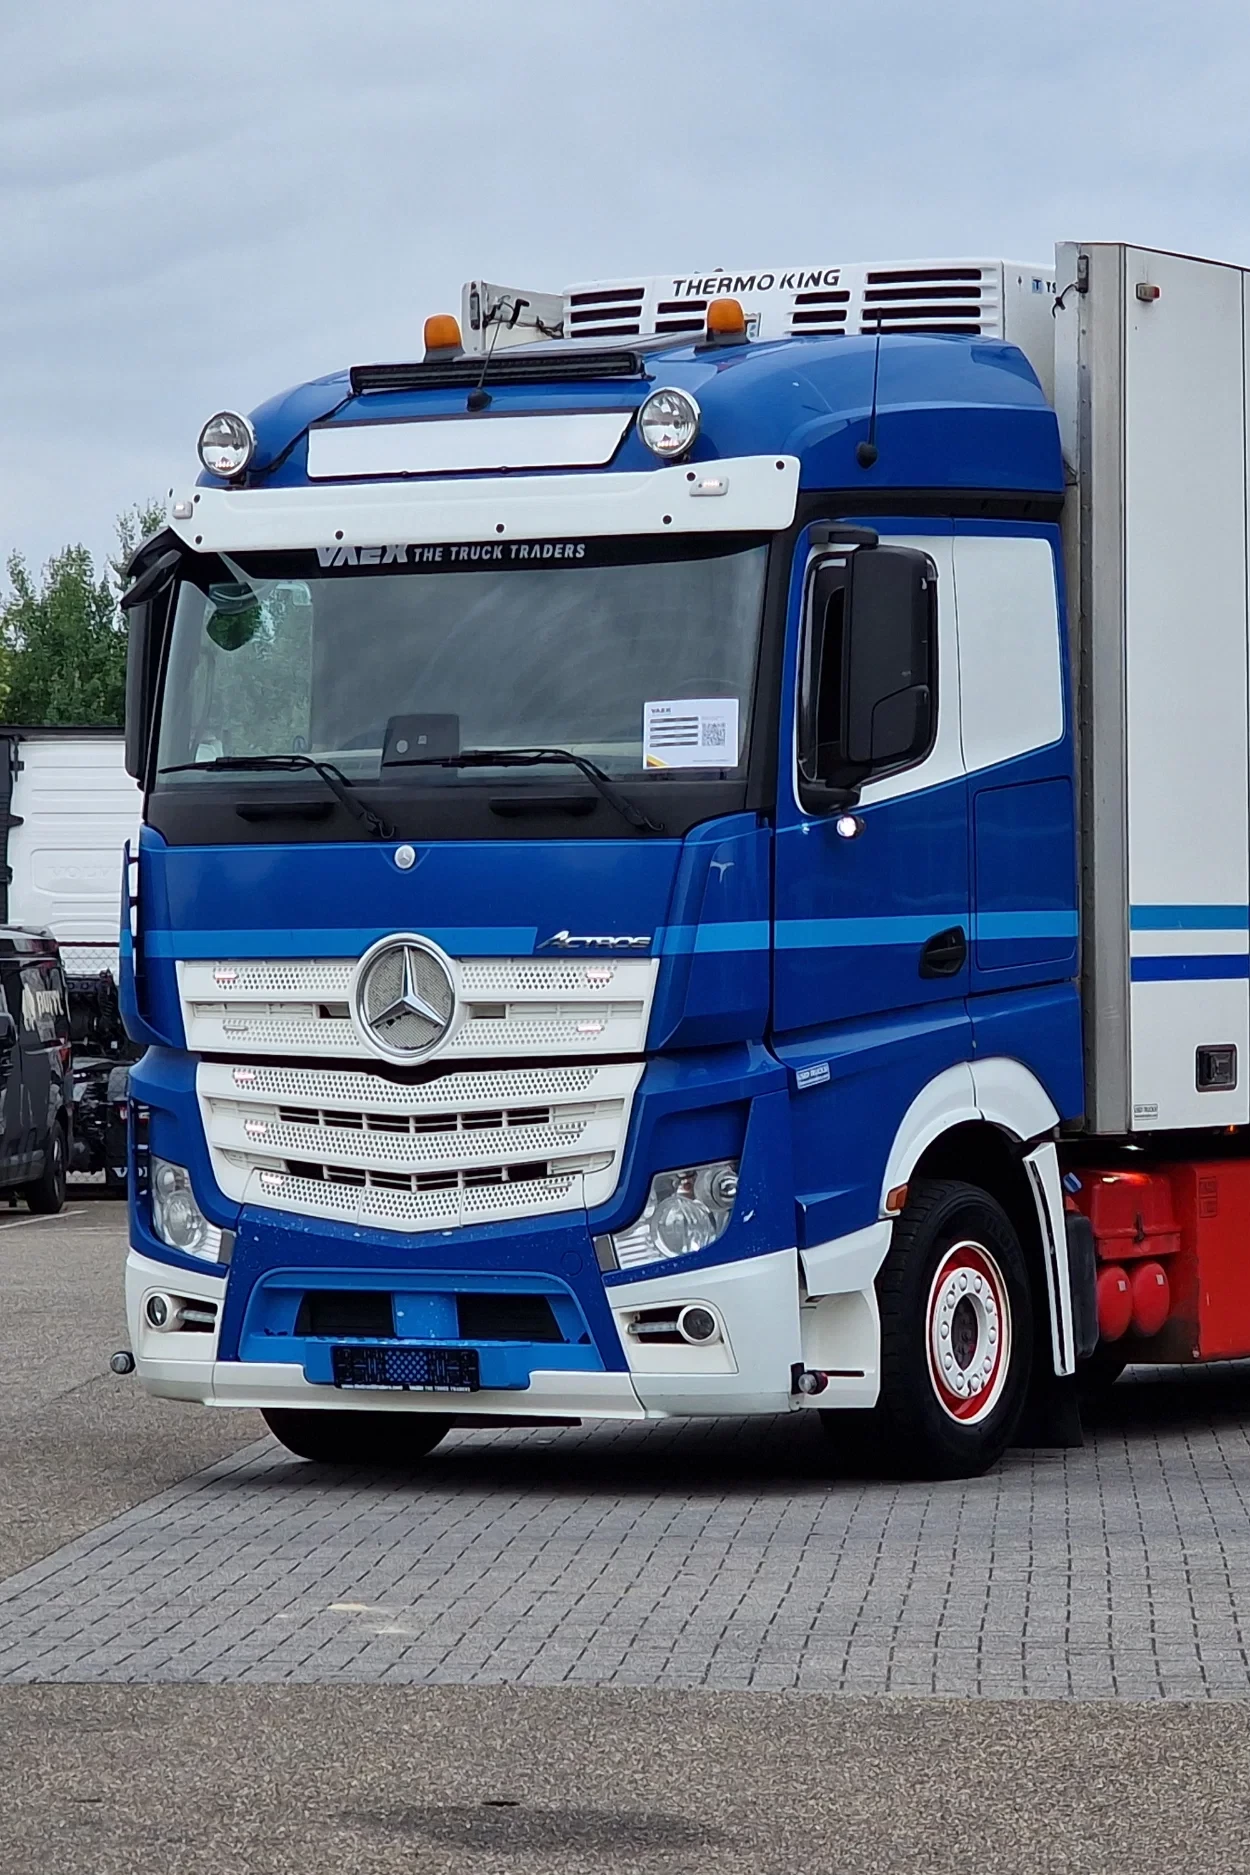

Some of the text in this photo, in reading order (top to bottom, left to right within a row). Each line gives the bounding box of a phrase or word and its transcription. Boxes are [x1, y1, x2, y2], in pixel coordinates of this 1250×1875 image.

[673, 269, 841, 297] THERMO KING
[413, 547, 443, 563] THE
[449, 545, 503, 561] TRUCK
[510, 543, 586, 559] TRADERS
